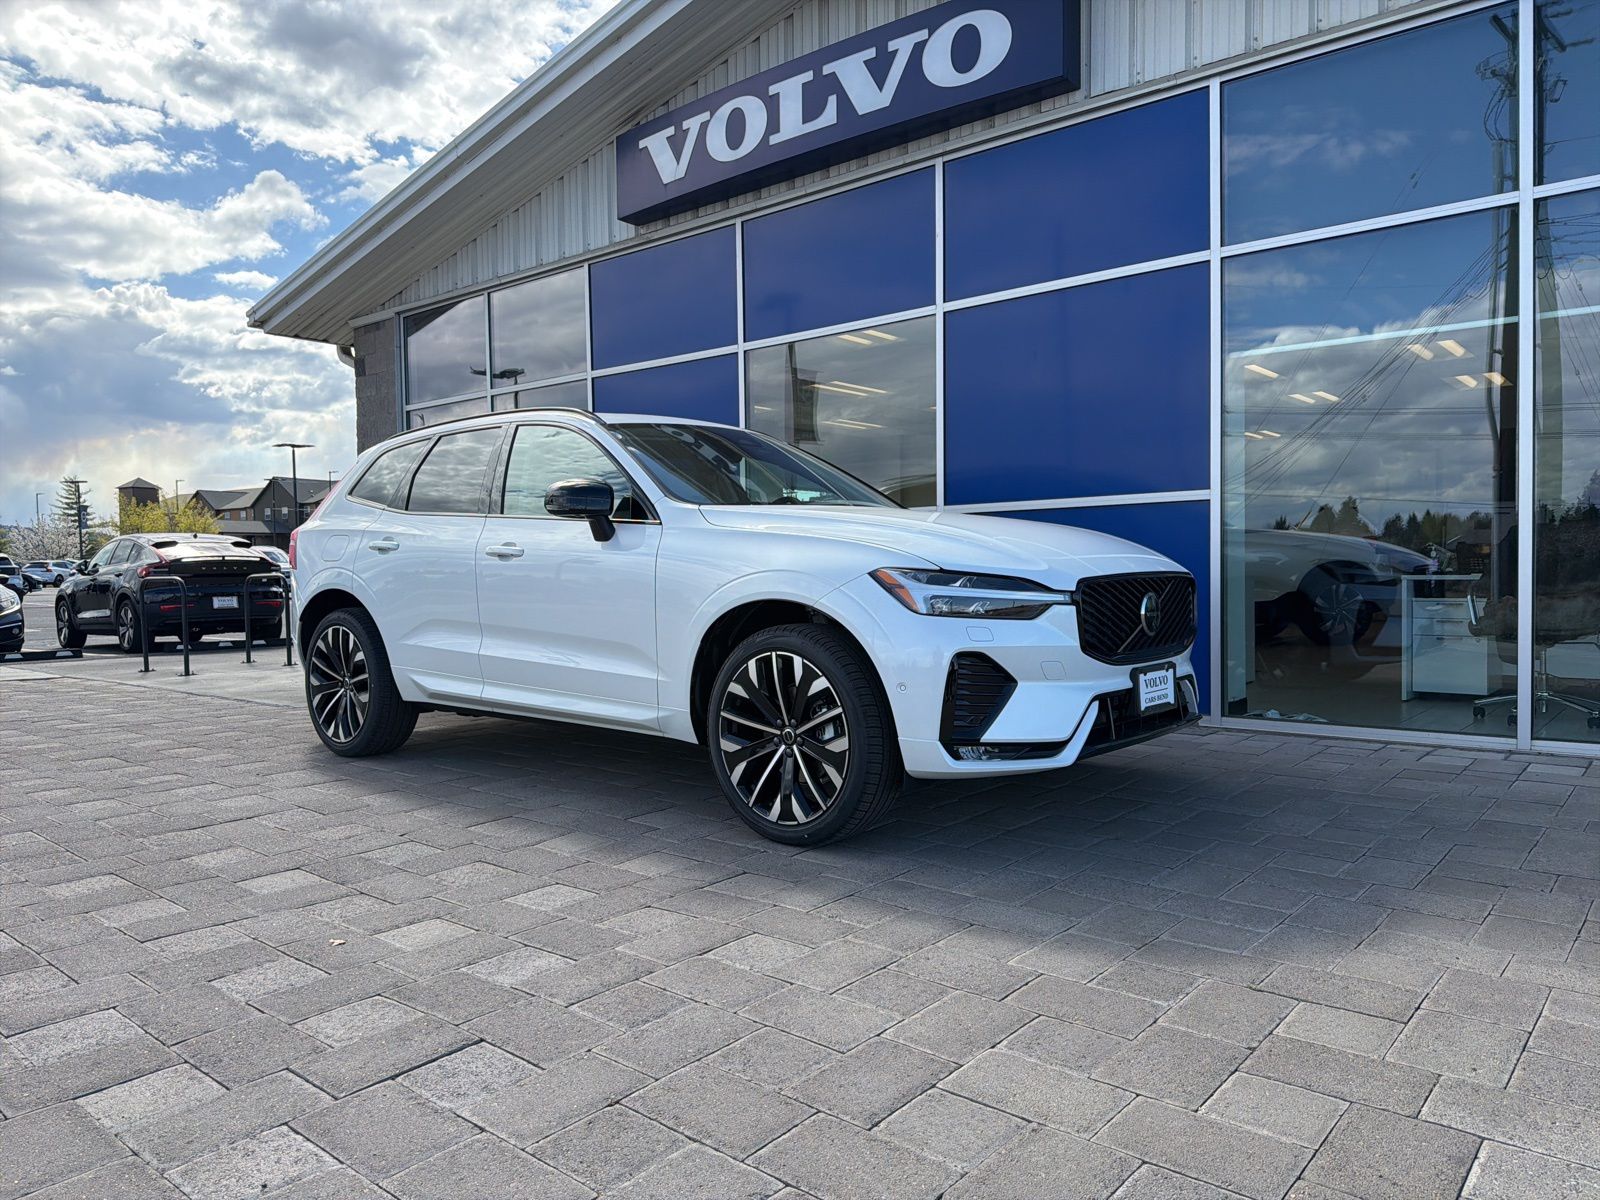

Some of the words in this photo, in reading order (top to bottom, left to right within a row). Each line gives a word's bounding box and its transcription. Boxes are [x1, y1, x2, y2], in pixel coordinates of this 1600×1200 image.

[639, 9, 1012, 184] VOLVO
[1144, 674, 1169, 689] VOLVO
[1144, 695, 1157, 704] CARS
